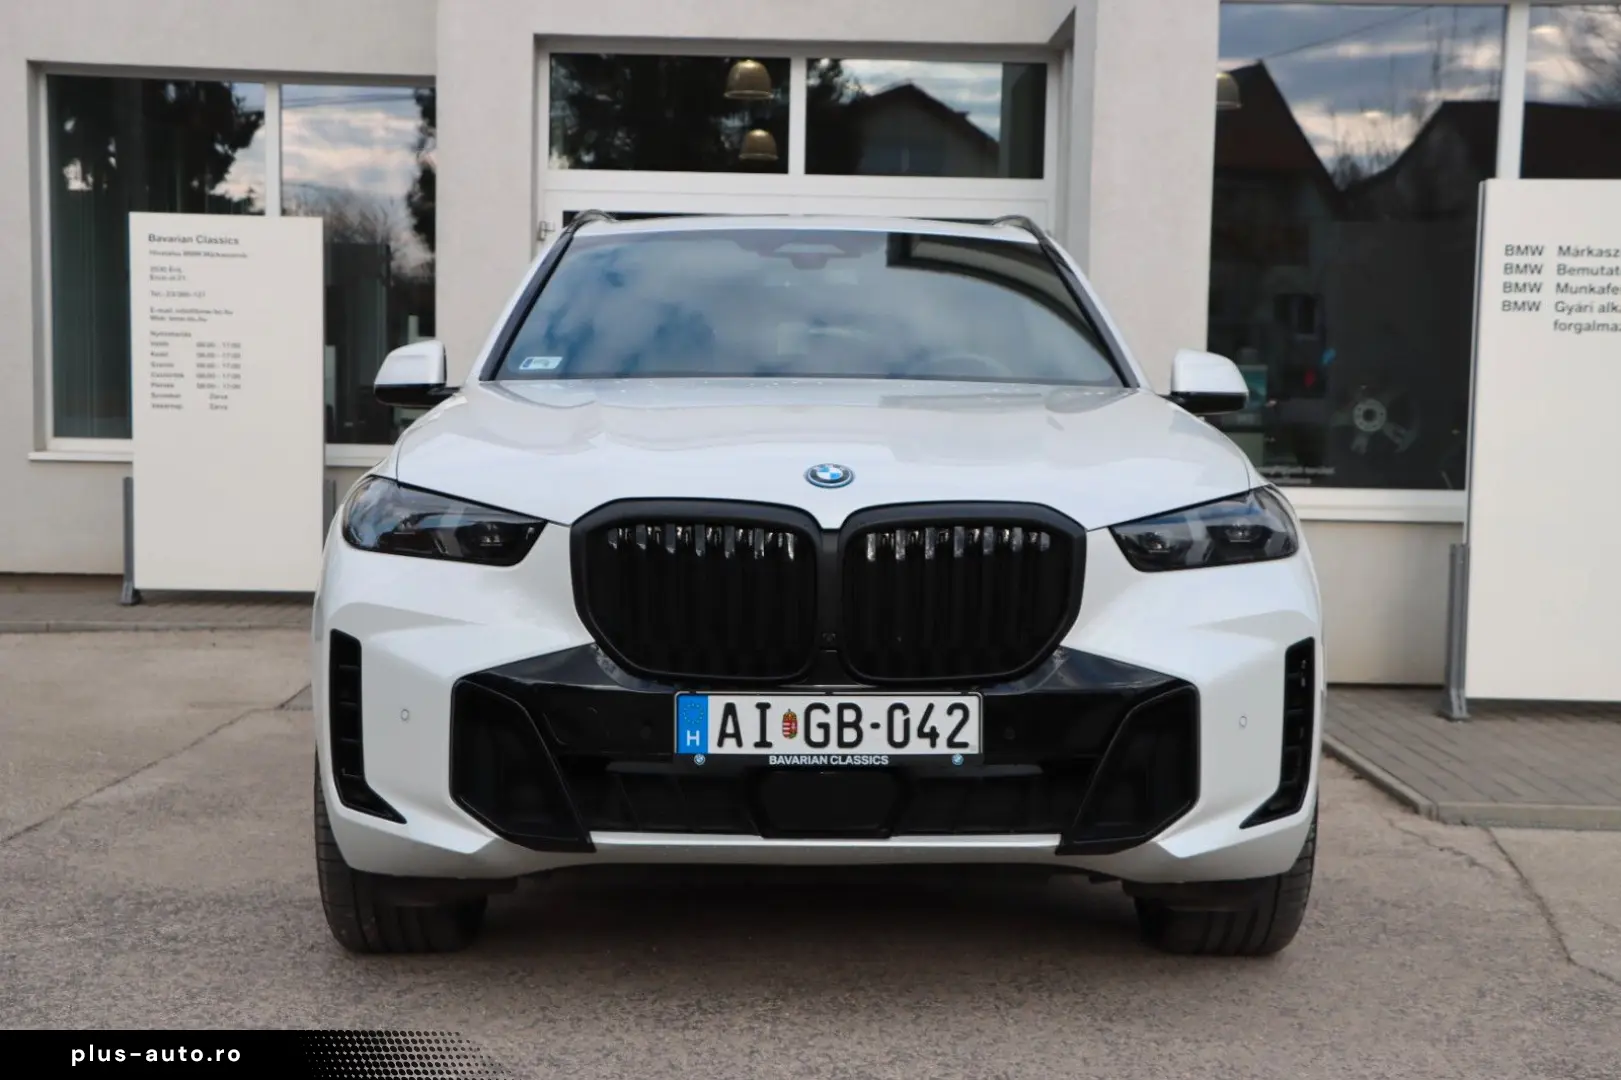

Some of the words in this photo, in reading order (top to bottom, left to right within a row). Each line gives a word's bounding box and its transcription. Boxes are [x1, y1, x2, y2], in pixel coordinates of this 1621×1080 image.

[148, 233, 194, 243] Bavarian
[196, 235, 240, 245] Classics
[1504, 244, 1544, 257] BMW
[1557, 243, 1620, 258] Márkasz
[1503, 263, 1543, 275] BMW
[1556, 263, 1621, 276] Bemutat
[1502, 281, 1542, 294] BMW
[1501, 300, 1541, 312] BMW
[1554, 300, 1594, 316] Gyári
[716, 702, 773, 748] AI
[803, 702, 970, 749] GB-042
[686, 730, 700, 746] H
[769, 755, 829, 765] BAVARIAN
[829, 755, 889, 765] CLASSICS
